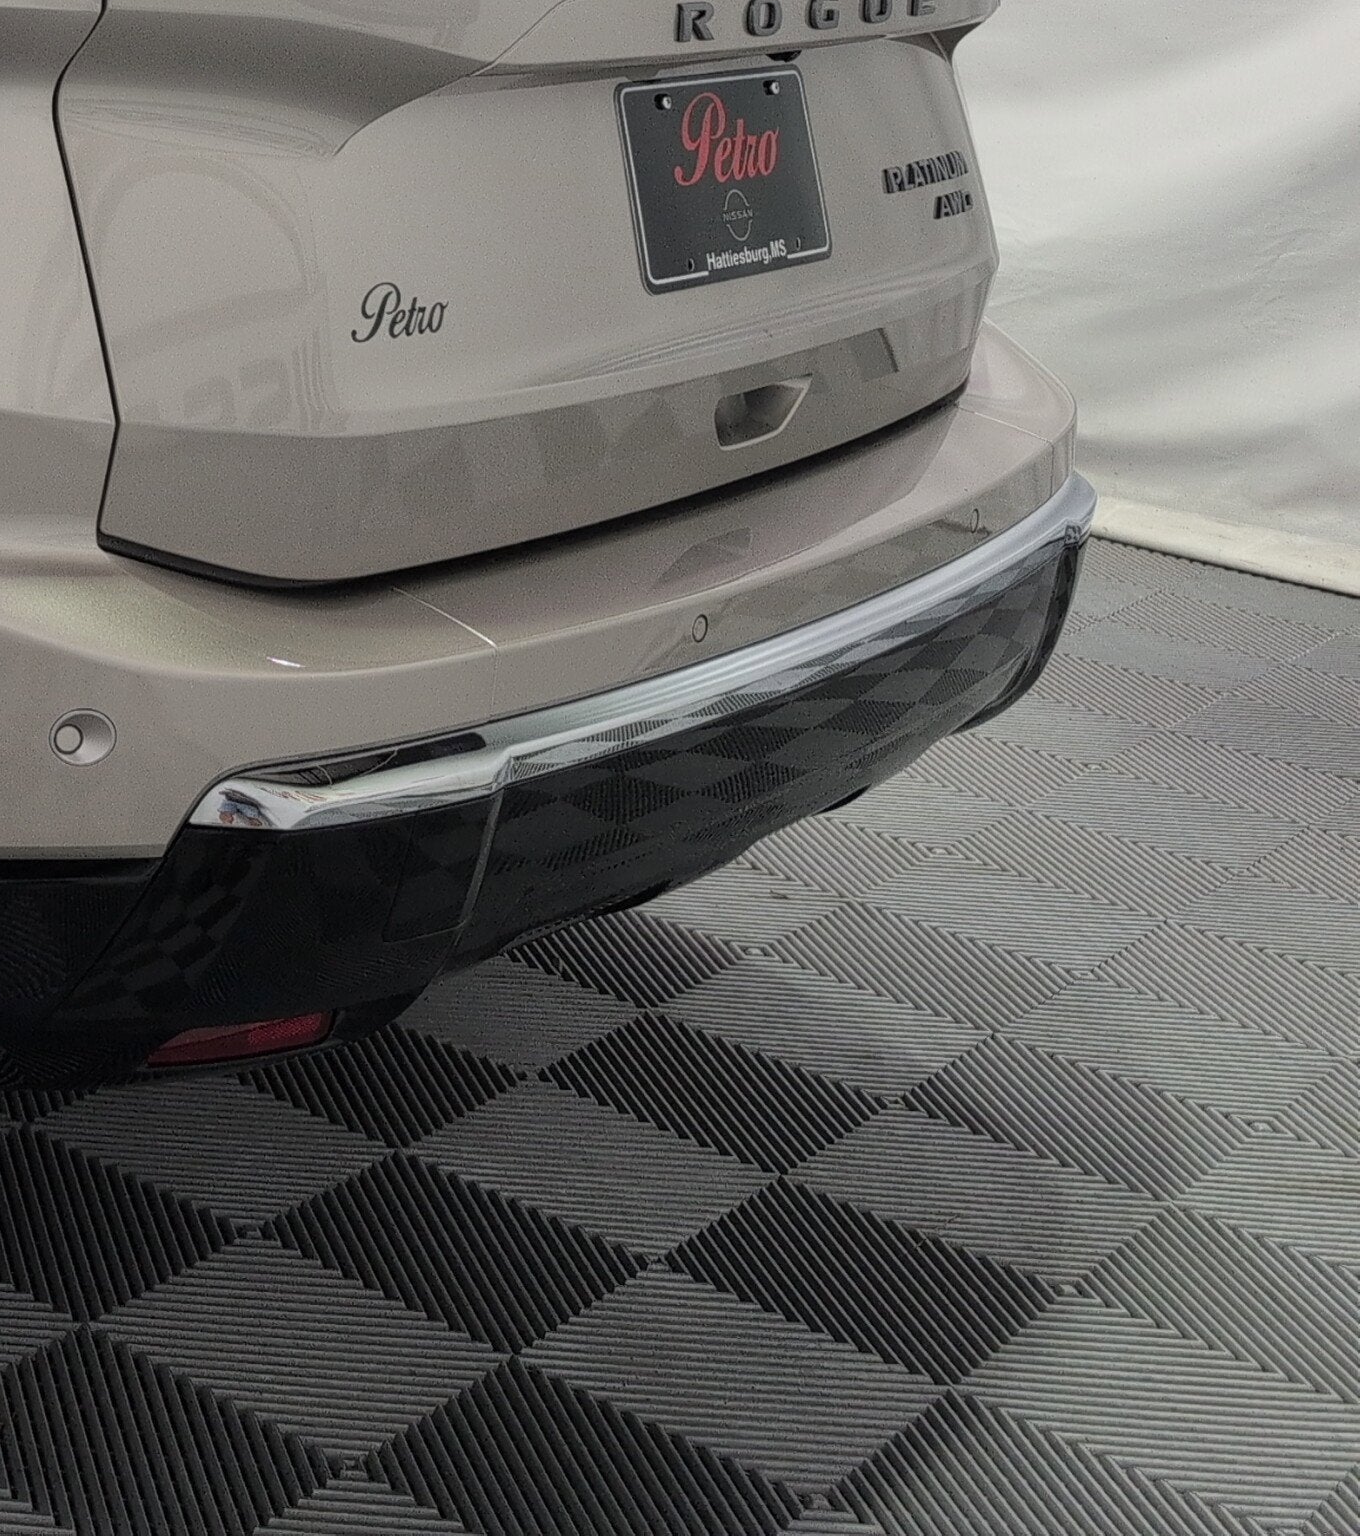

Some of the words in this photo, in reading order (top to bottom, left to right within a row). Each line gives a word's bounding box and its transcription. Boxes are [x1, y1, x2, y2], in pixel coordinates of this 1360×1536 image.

[674, 91, 780, 186] Petro
[882, 150, 969, 194] PLATINUM
[723, 209, 753, 222] NISSAN
[350, 282, 449, 343] Petro
